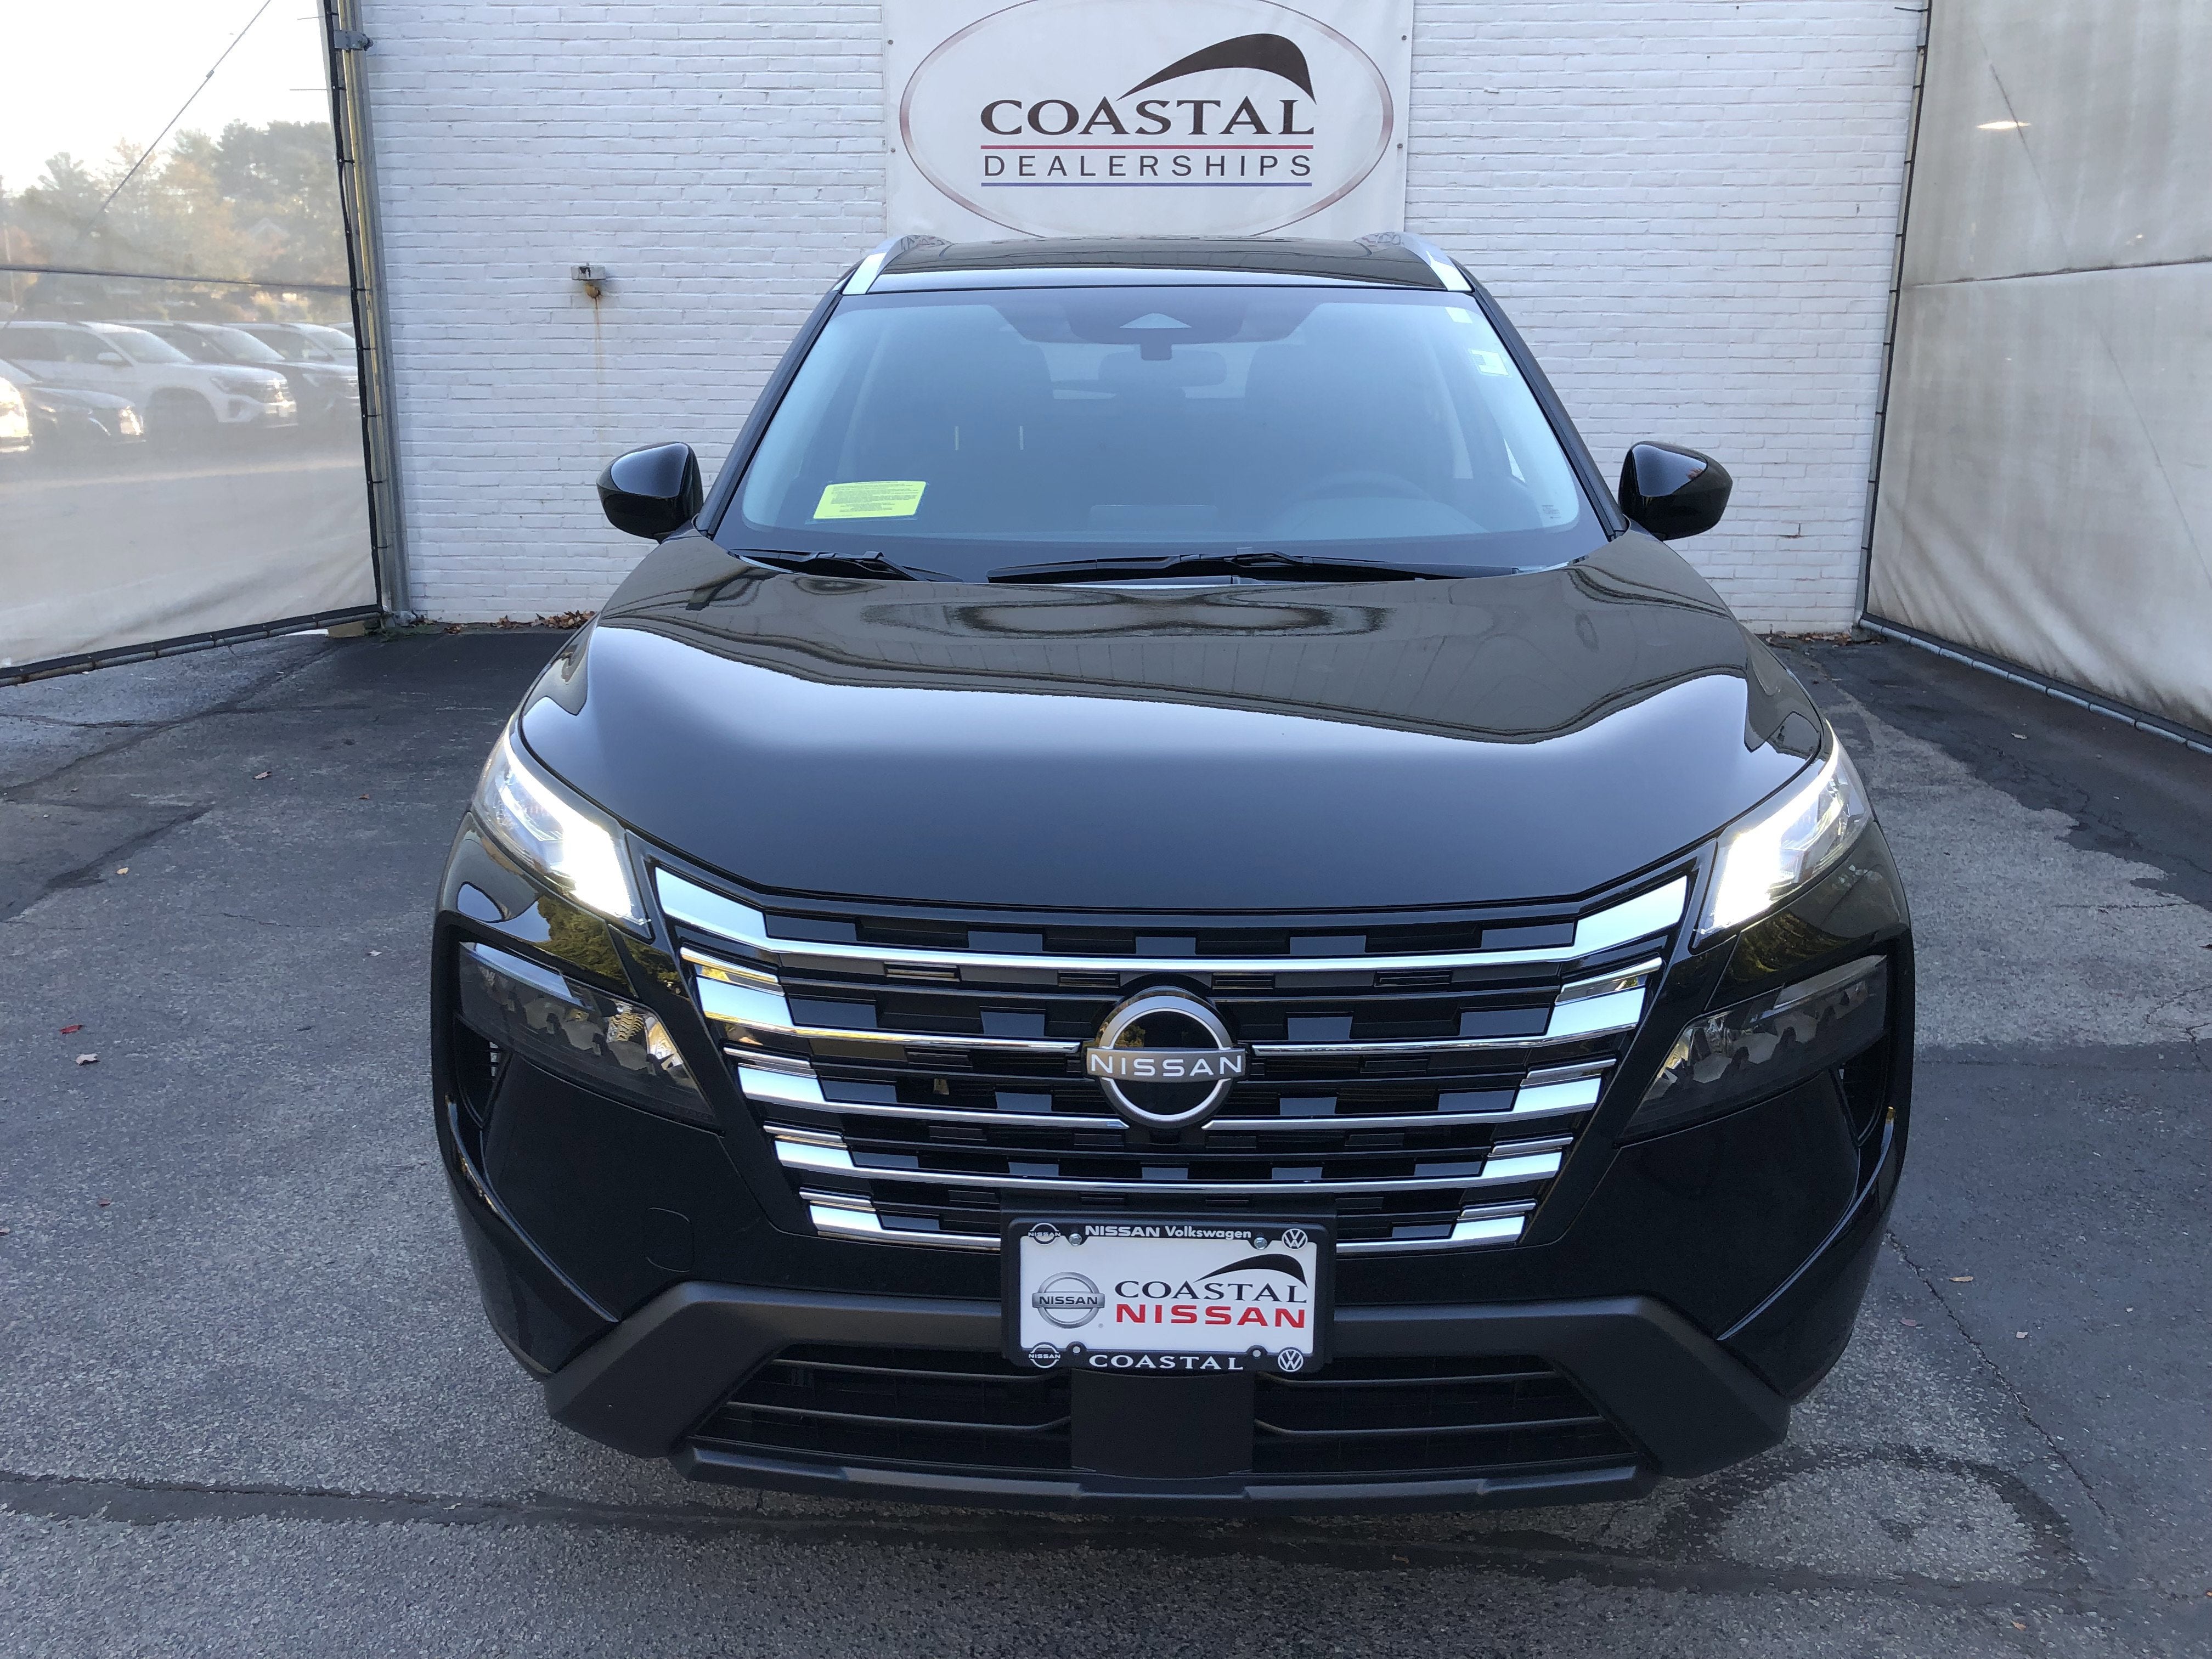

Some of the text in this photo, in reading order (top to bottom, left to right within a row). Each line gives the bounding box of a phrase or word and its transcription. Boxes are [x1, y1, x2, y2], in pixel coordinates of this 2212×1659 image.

[980, 95, 1314, 136] COASTAL
[984, 155, 1311, 177] DEALERSHIPS
[1091, 1054, 1242, 1077] NISSAN
[1085, 1225, 1251, 1240] NISSAN Volkswagen
[1039, 1295, 1098, 1305] NISSAN
[1115, 1280, 1307, 1304] COASTAL
[1116, 1304, 1305, 1328] NISSAN
[1089, 1355, 1244, 1370] COASTAL
